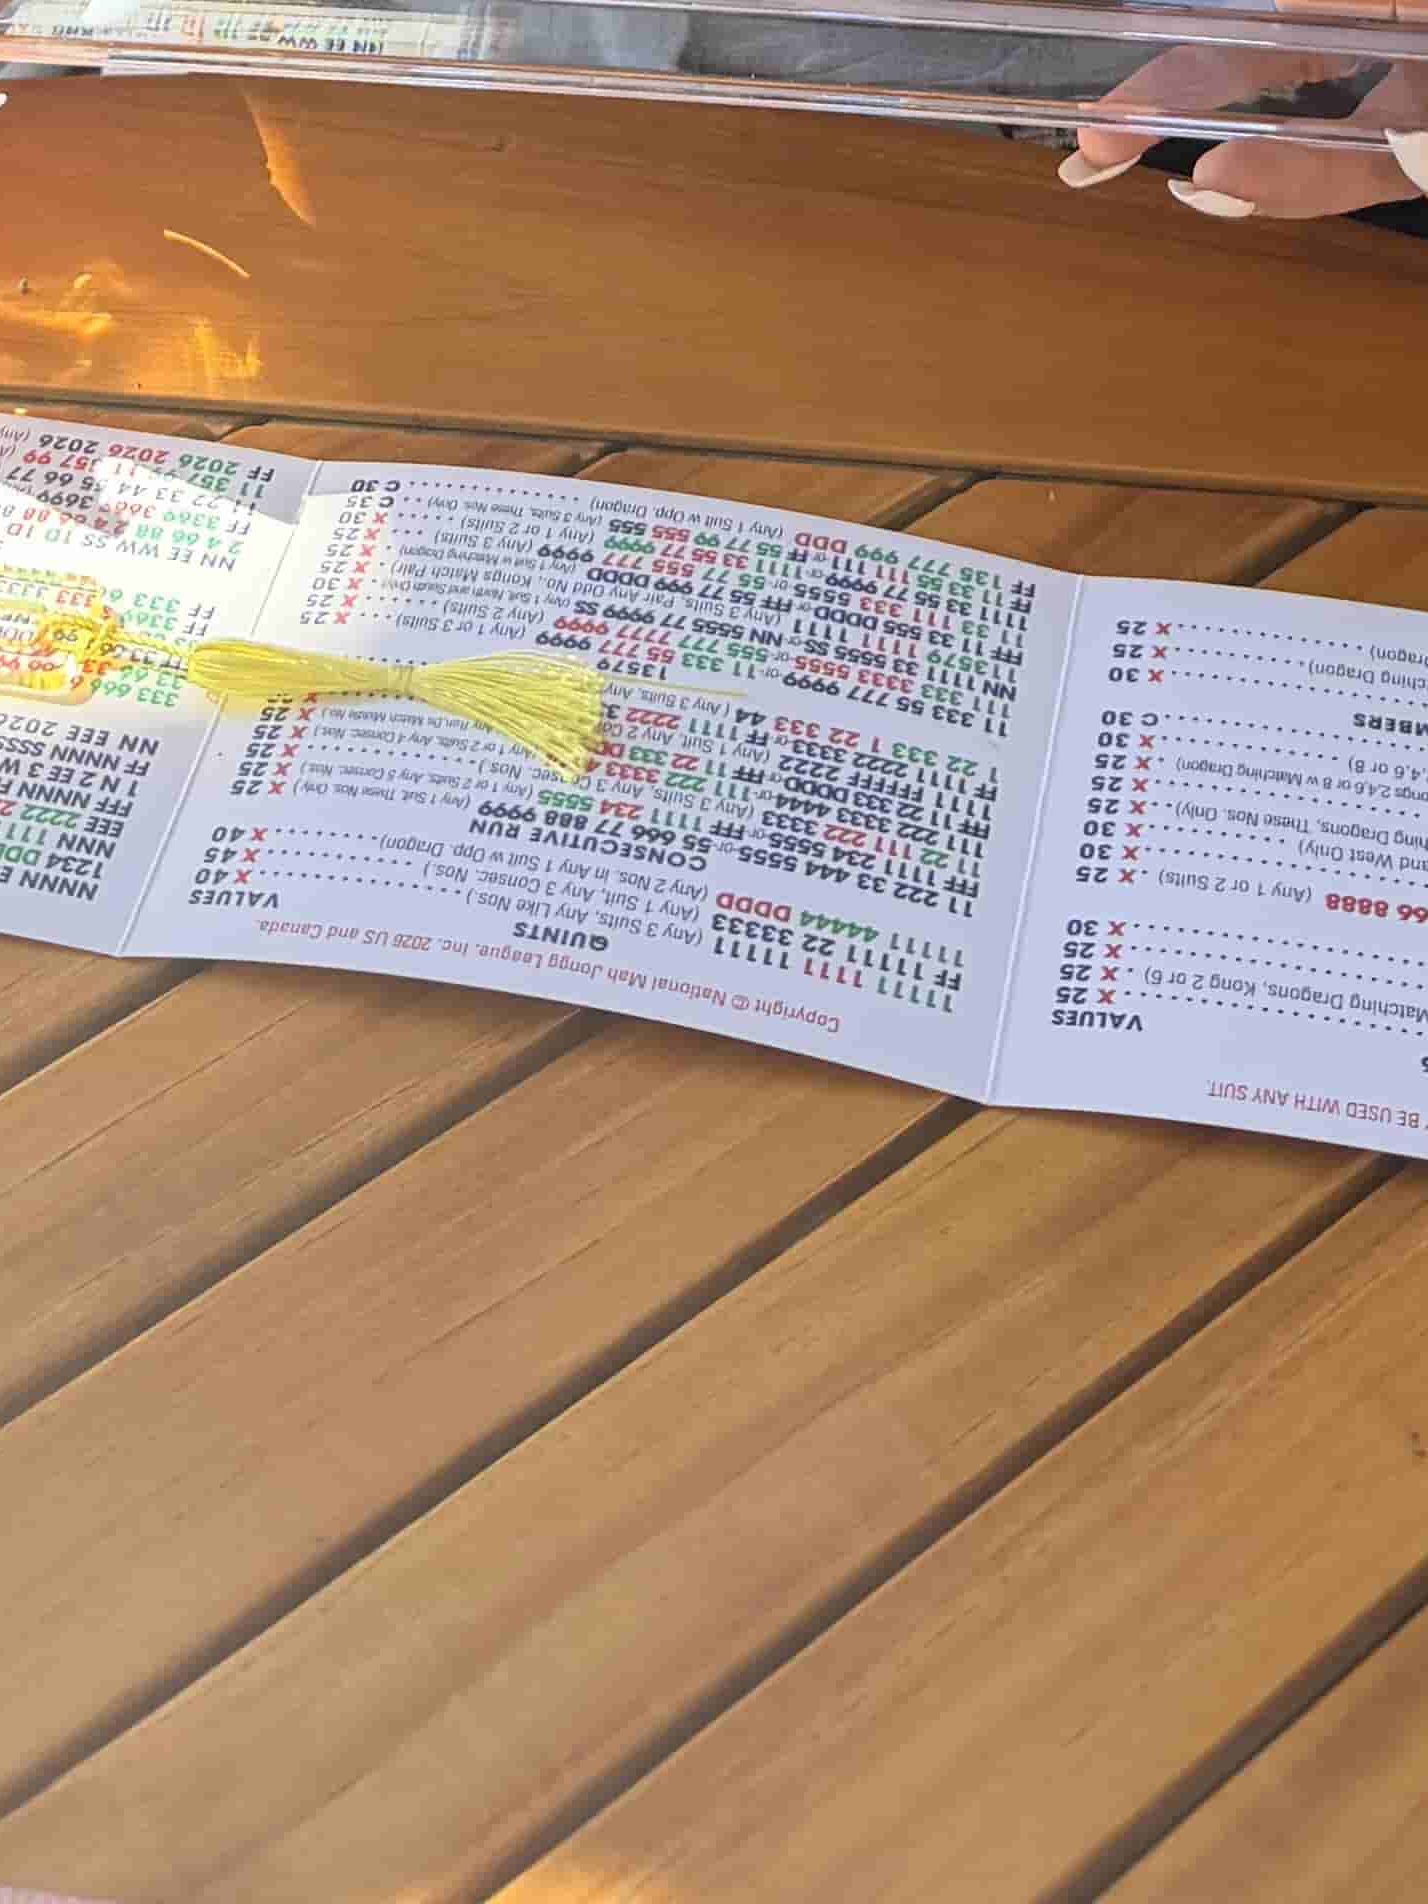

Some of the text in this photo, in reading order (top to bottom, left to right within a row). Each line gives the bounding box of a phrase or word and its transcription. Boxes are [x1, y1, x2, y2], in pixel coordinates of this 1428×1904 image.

[596, 658, 666, 681] 13579
[16, 781, 92, 809] NNNN
[19, 803, 82, 829] 2222
[93, 796, 133, 818] FFF
[83, 815, 124, 838] EEE
[468, 819, 707, 872] CONSECUTIVE RUN
[188, 889, 278, 909] VALUES
[1325, 893, 1389, 918] 8888
[325, 925, 359, 939] and
[362, 929, 388, 947] US
[512, 921, 609, 951] QUINTS
[547, 953, 603, 980] Jongg
[607, 967, 647, 989] Mah
[651, 976, 726, 1007] National
[754, 999, 839, 1033] Copyright
[1051, 1009, 1143, 1032] VALUES
[1251, 1087, 1289, 1107] ANY
[1293, 1093, 1340, 1115] WITH
[1346, 1101, 1392, 1123] USED
[1396, 1110, 1420, 1128] BE
